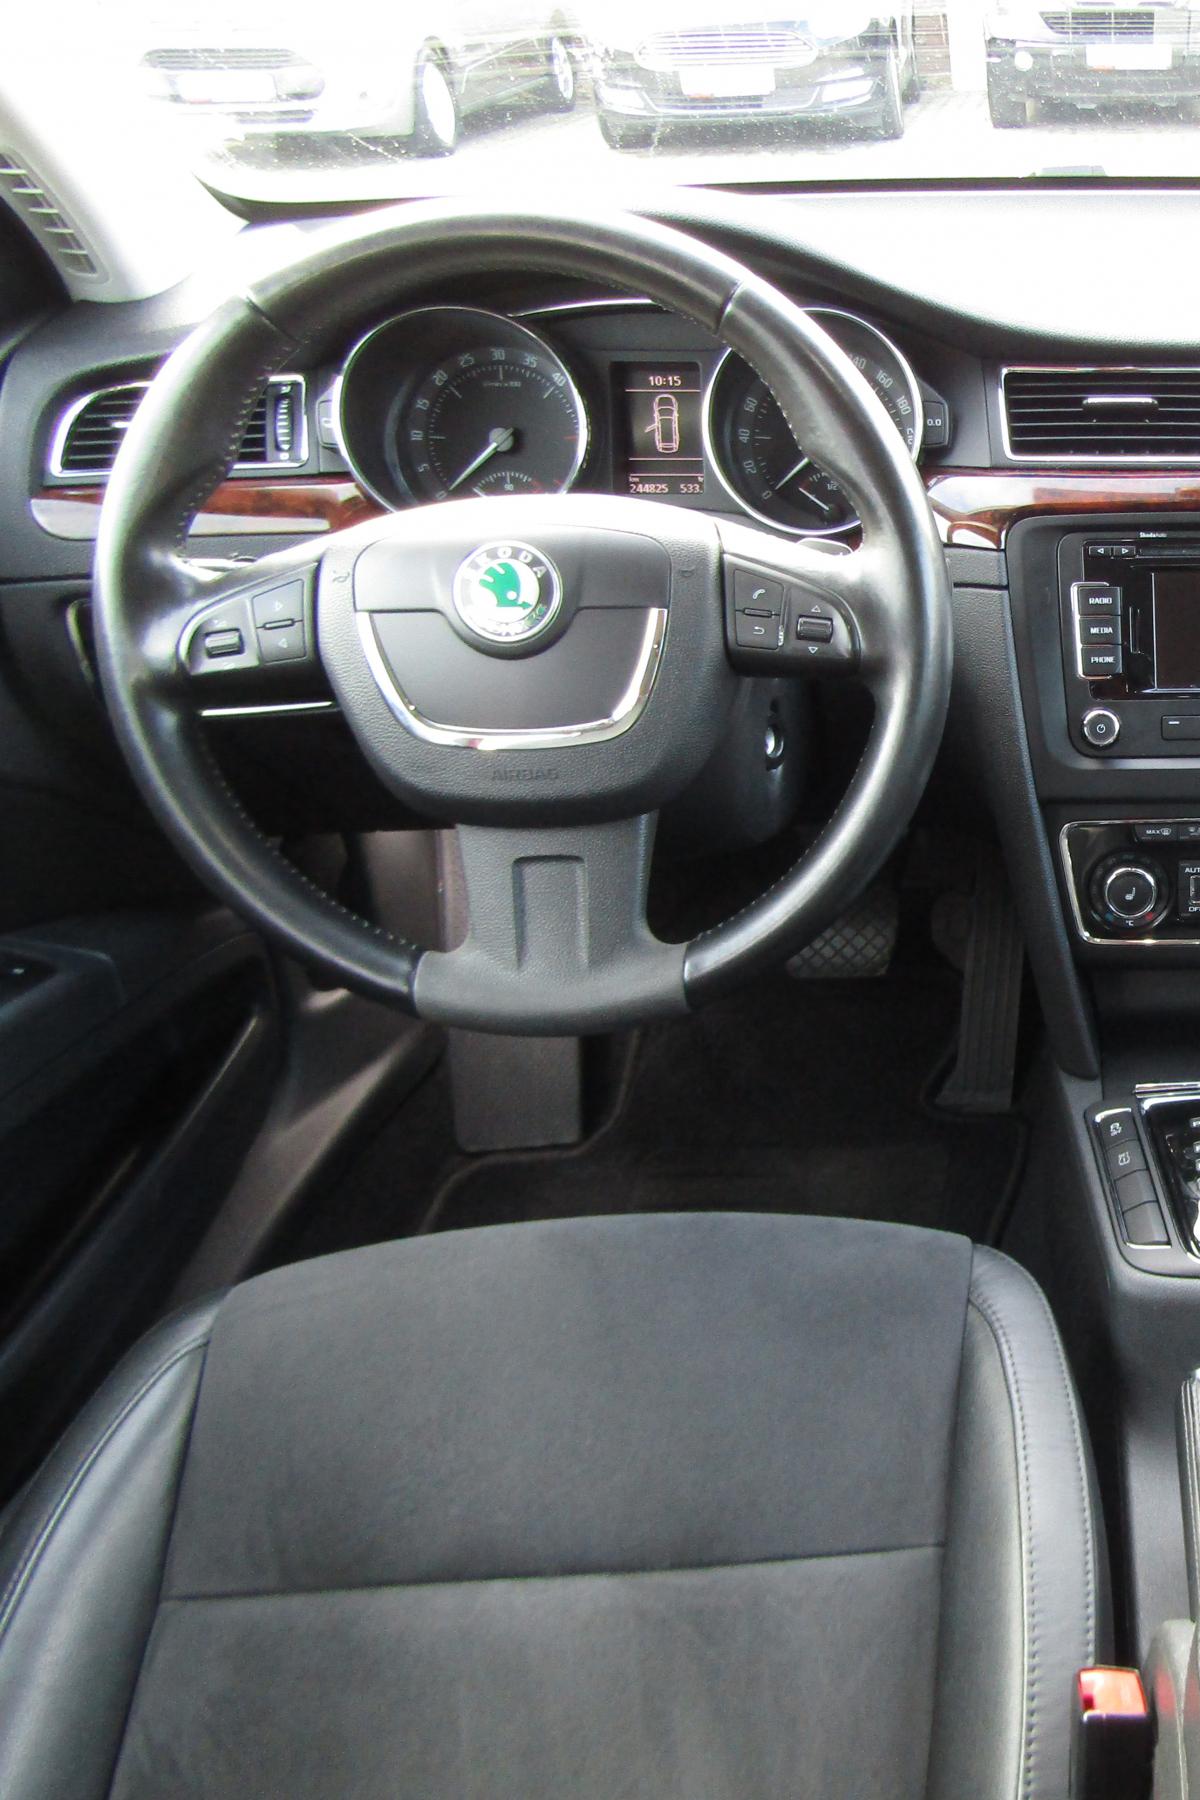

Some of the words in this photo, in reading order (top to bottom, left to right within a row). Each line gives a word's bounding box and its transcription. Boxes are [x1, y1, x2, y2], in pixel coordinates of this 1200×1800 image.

[457, 353, 475, 368] 25
[491, 349, 506, 360] 30
[522, 353, 539, 368] 35
[433, 369, 449, 386] 20
[551, 371, 567, 387] 40
[648, 375, 682, 387] 10:15
[875, 369, 895, 389] 160
[415, 398, 430, 411] 15
[743, 397, 759, 413] 60
[895, 395, 912, 416] 180
[410, 430, 424, 441] 10
[738, 428, 751, 444] 40
[743, 459, 757, 475] 20
[629, 483, 669, 494] 244825
[1088, 597, 1113, 605] RADIO
[1090, 626, 1114, 634] MEDIA
